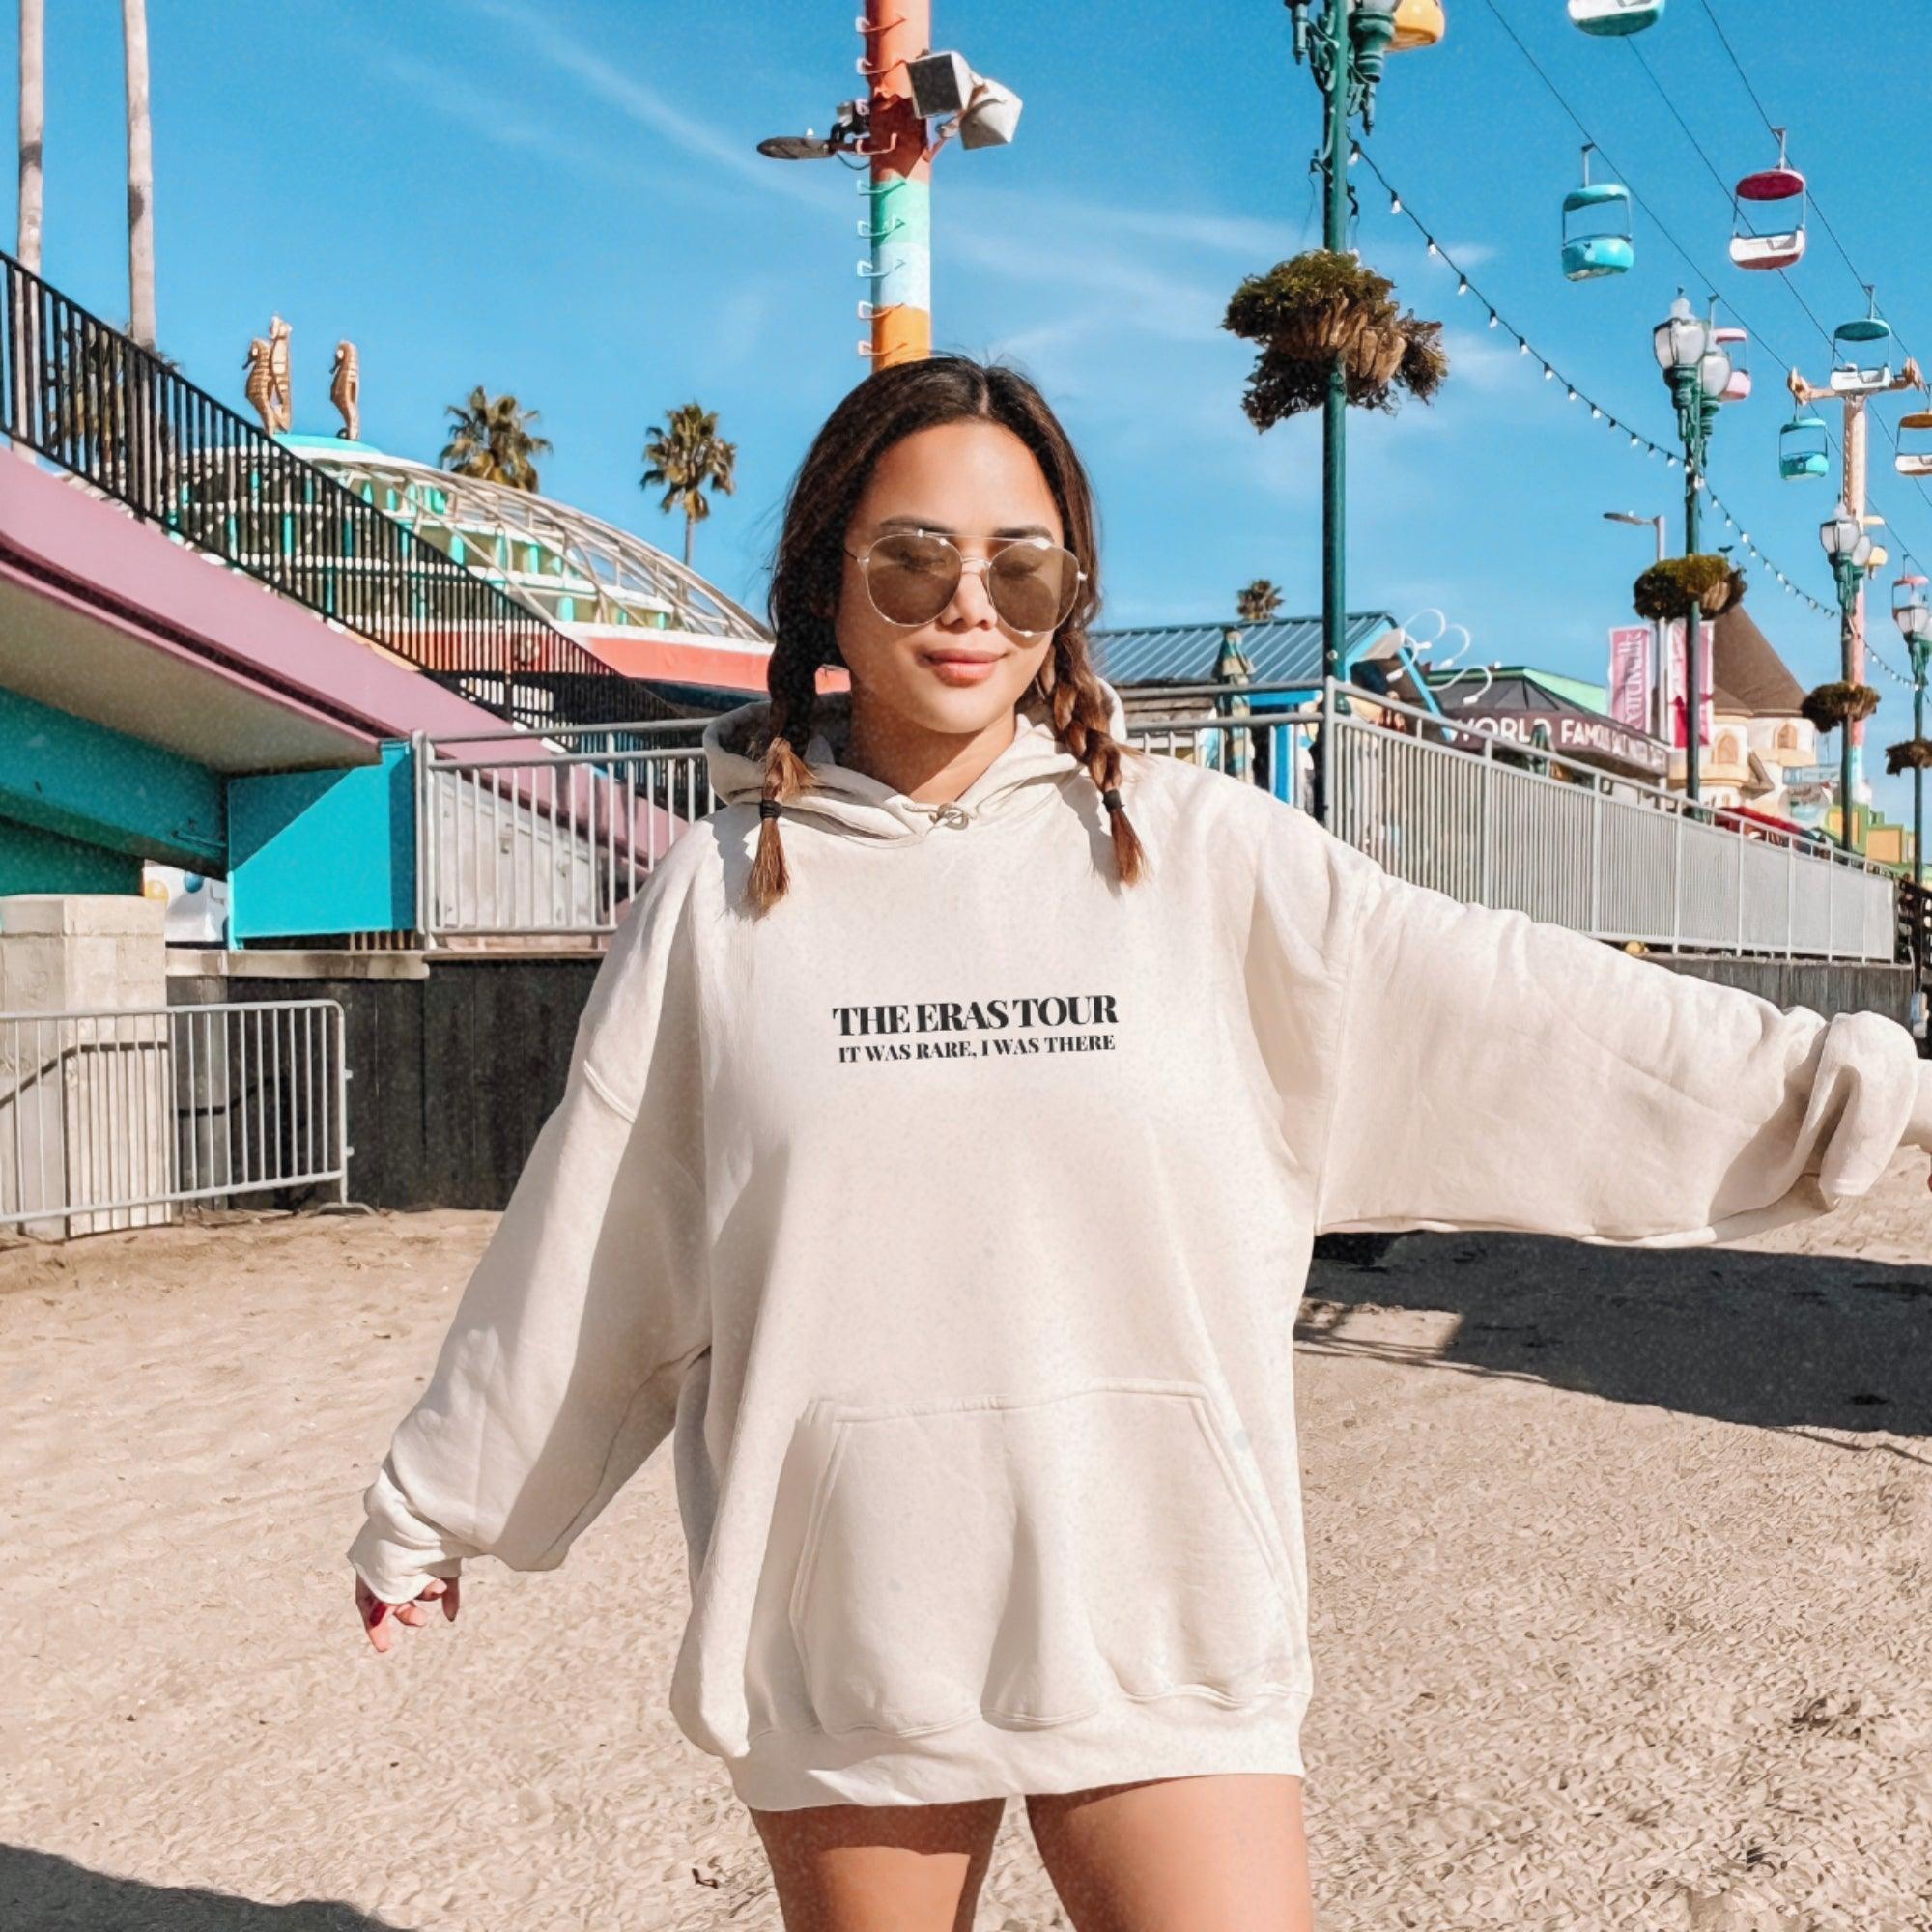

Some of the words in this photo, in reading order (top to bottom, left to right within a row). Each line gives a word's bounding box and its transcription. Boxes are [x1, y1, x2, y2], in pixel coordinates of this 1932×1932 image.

[833, 1005, 911, 1036] THE
[916, 1000, 1009, 1032] ERAS
[1012, 995, 1119, 1027] TOUR
[838, 1046, 861, 1063] IT
[865, 1044, 912, 1061] WAS
[915, 1041, 978, 1060] RARE,
[981, 1039, 990, 1057] I
[993, 1037, 1040, 1055] WAS
[1043, 1035, 1117, 1053] THERE
